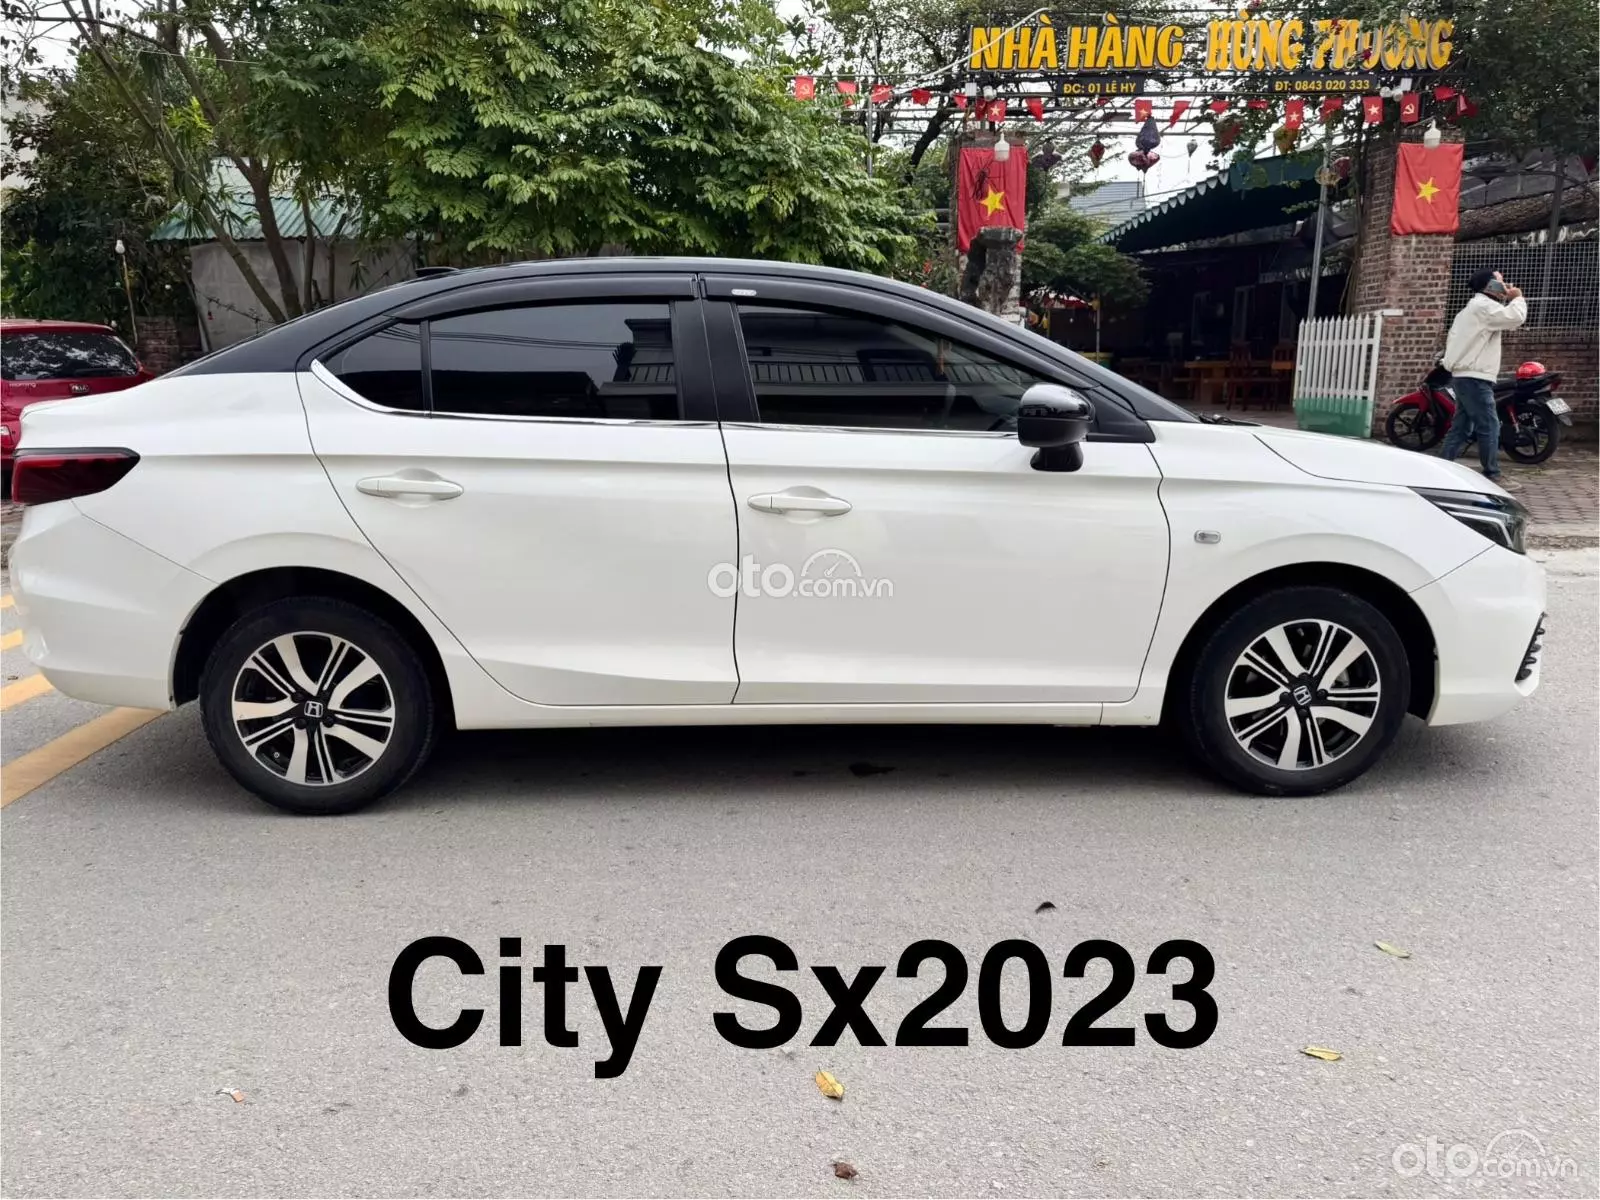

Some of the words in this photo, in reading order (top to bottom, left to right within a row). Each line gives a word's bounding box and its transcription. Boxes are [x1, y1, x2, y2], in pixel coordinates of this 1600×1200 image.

[969, 13, 1059, 70] NHÀ
[1066, 12, 1185, 70] HÀNG
[1203, 8, 1305, 72] HÙNG
[1062, 82, 1086, 94] ĐC:
[1087, 82, 1101, 94] 01
[1119, 82, 1137, 93] HY
[1294, 80, 1323, 91] 0843
[1324, 79, 1347, 90] 020
[1348, 79, 1371, 90] 333
